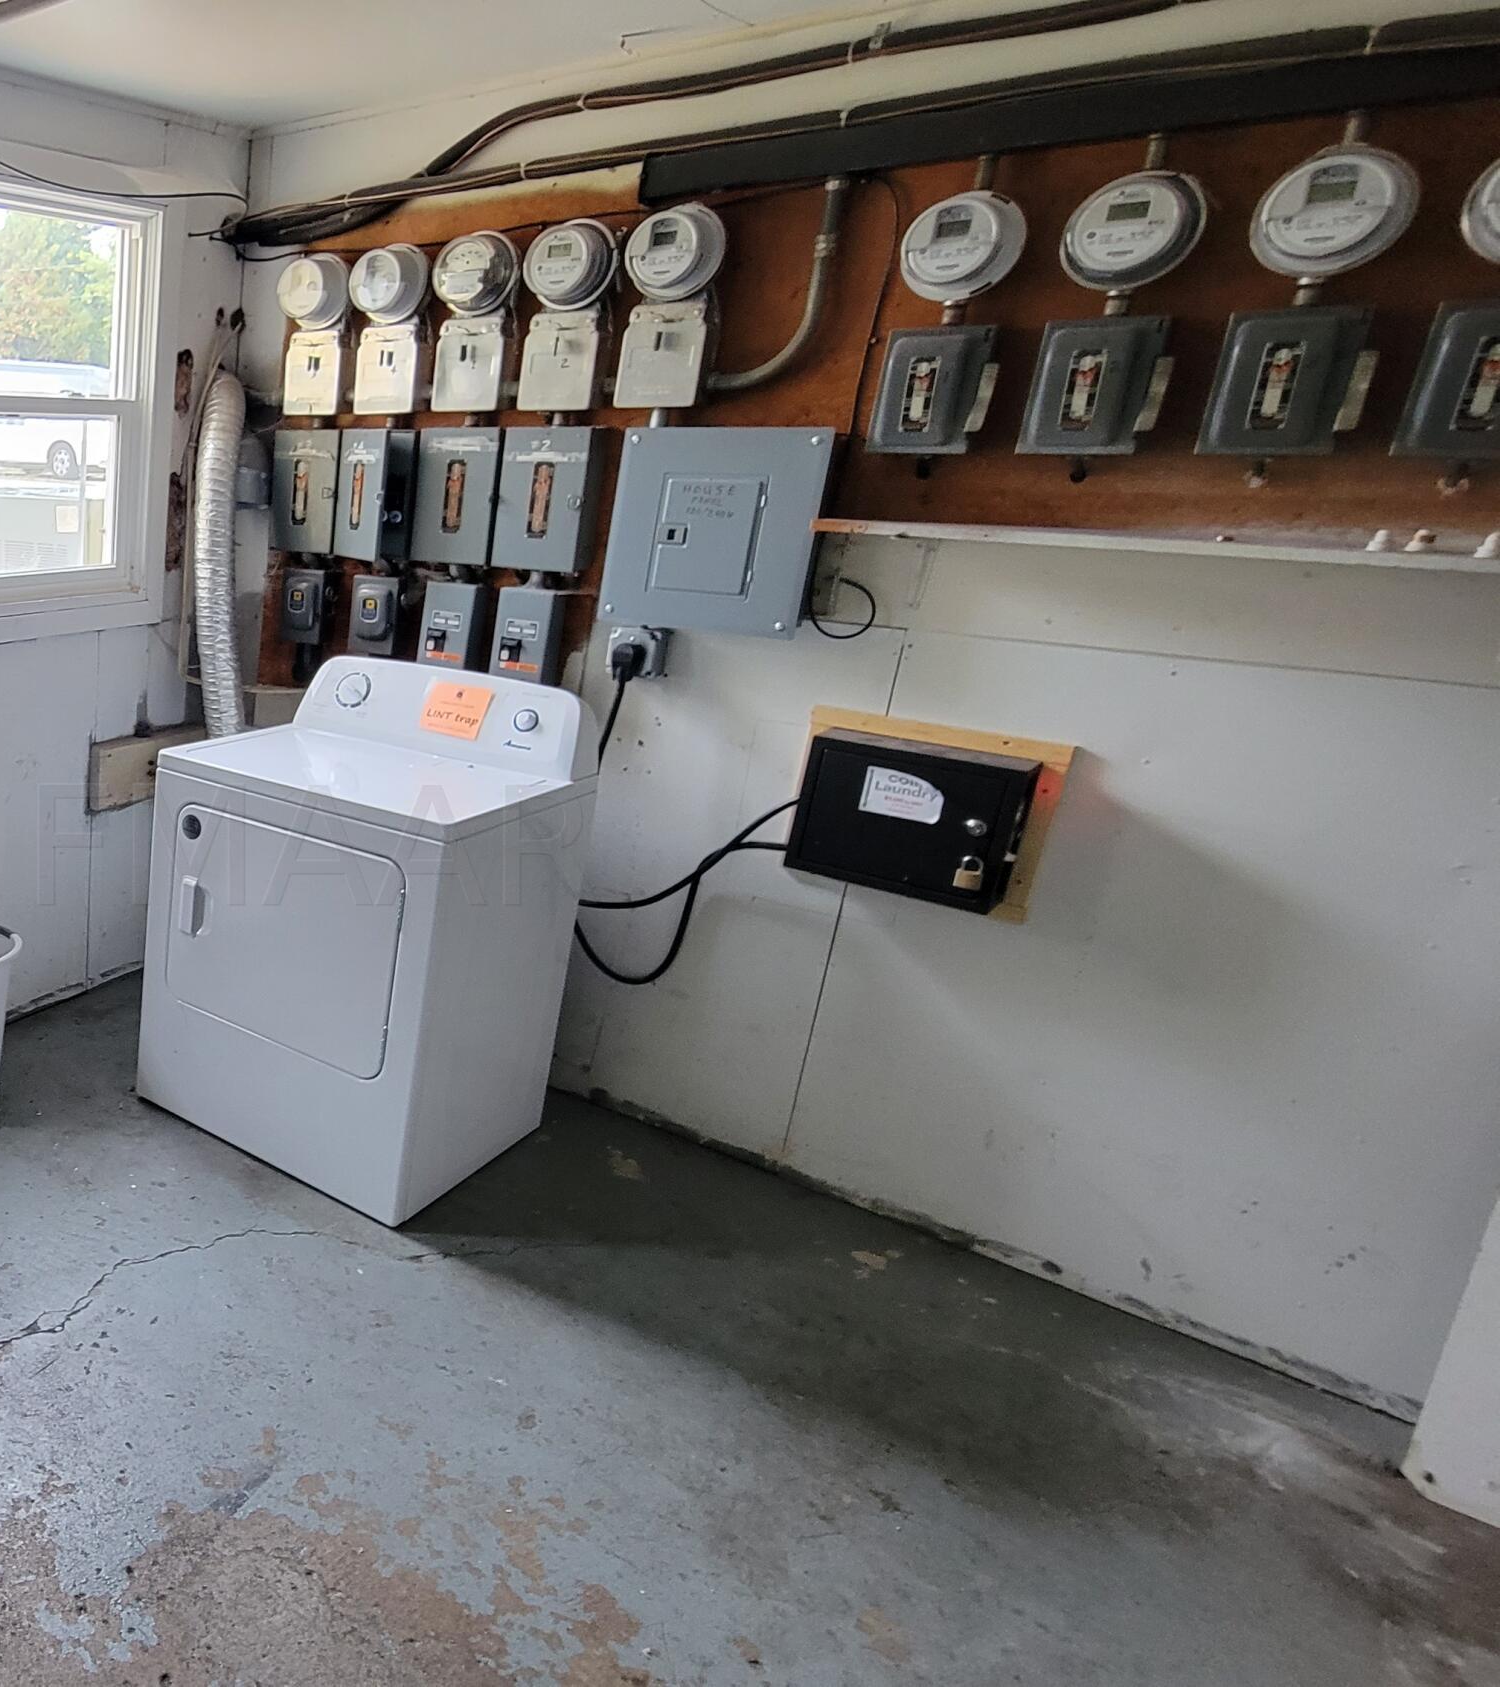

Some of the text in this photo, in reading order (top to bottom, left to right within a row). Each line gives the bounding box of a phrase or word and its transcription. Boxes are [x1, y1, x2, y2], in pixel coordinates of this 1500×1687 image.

[683, 484, 736, 496] HOUSE
[426, 708, 453, 720] LINT
[455, 713, 479, 728] trap
[874, 780, 938, 802] Laundry
